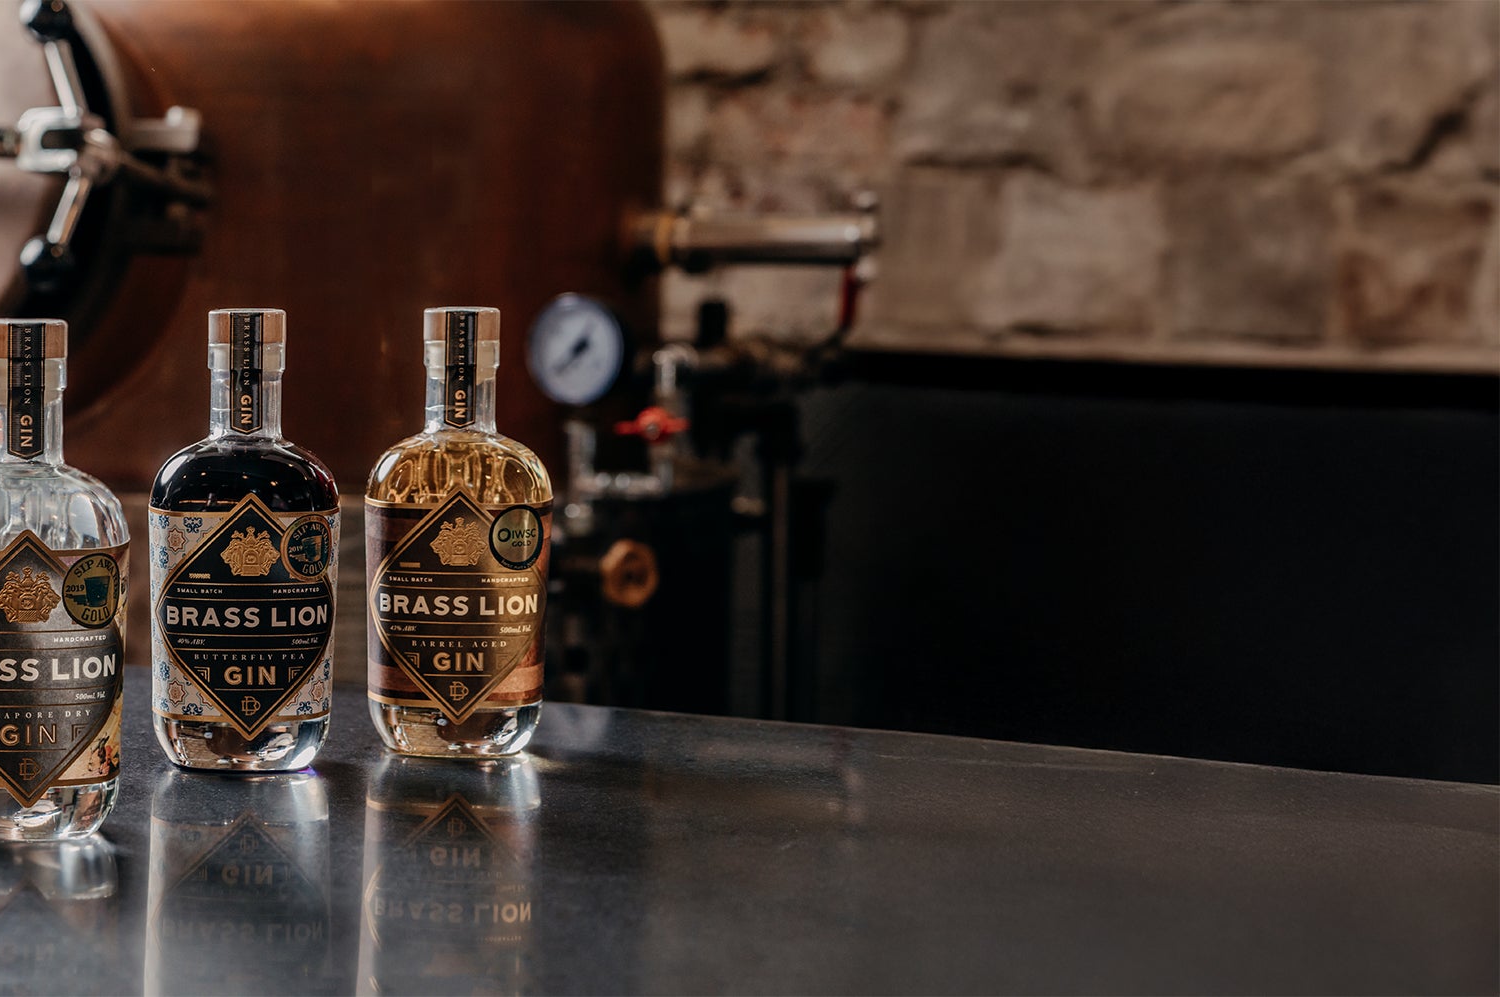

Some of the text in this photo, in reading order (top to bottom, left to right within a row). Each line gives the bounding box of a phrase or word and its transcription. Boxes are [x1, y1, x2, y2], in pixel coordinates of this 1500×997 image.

[243, 316, 251, 352] BRASS
[20, 327, 33, 448] BRASS LION GIN
[240, 394, 252, 424] GIN
[454, 390, 467, 419] GIN
[293, 524, 308, 541] SIP
[512, 528, 536, 539] IWSC
[74, 560, 94, 578] SIP
[302, 560, 324, 574] GOLD
[65, 584, 85, 592] 2019
[380, 592, 538, 616] BRASS LION
[81, 606, 110, 622] GOLD
[166, 604, 328, 628] BRASS LION
[53, 635, 107, 643] HANDCRAFTED
[411, 640, 507, 648] BARREL AGED
[52, 653, 116, 681] LION
[433, 651, 484, 672] GIN
[224, 665, 276, 686] GIN
[65, 709, 91, 718] DRY
